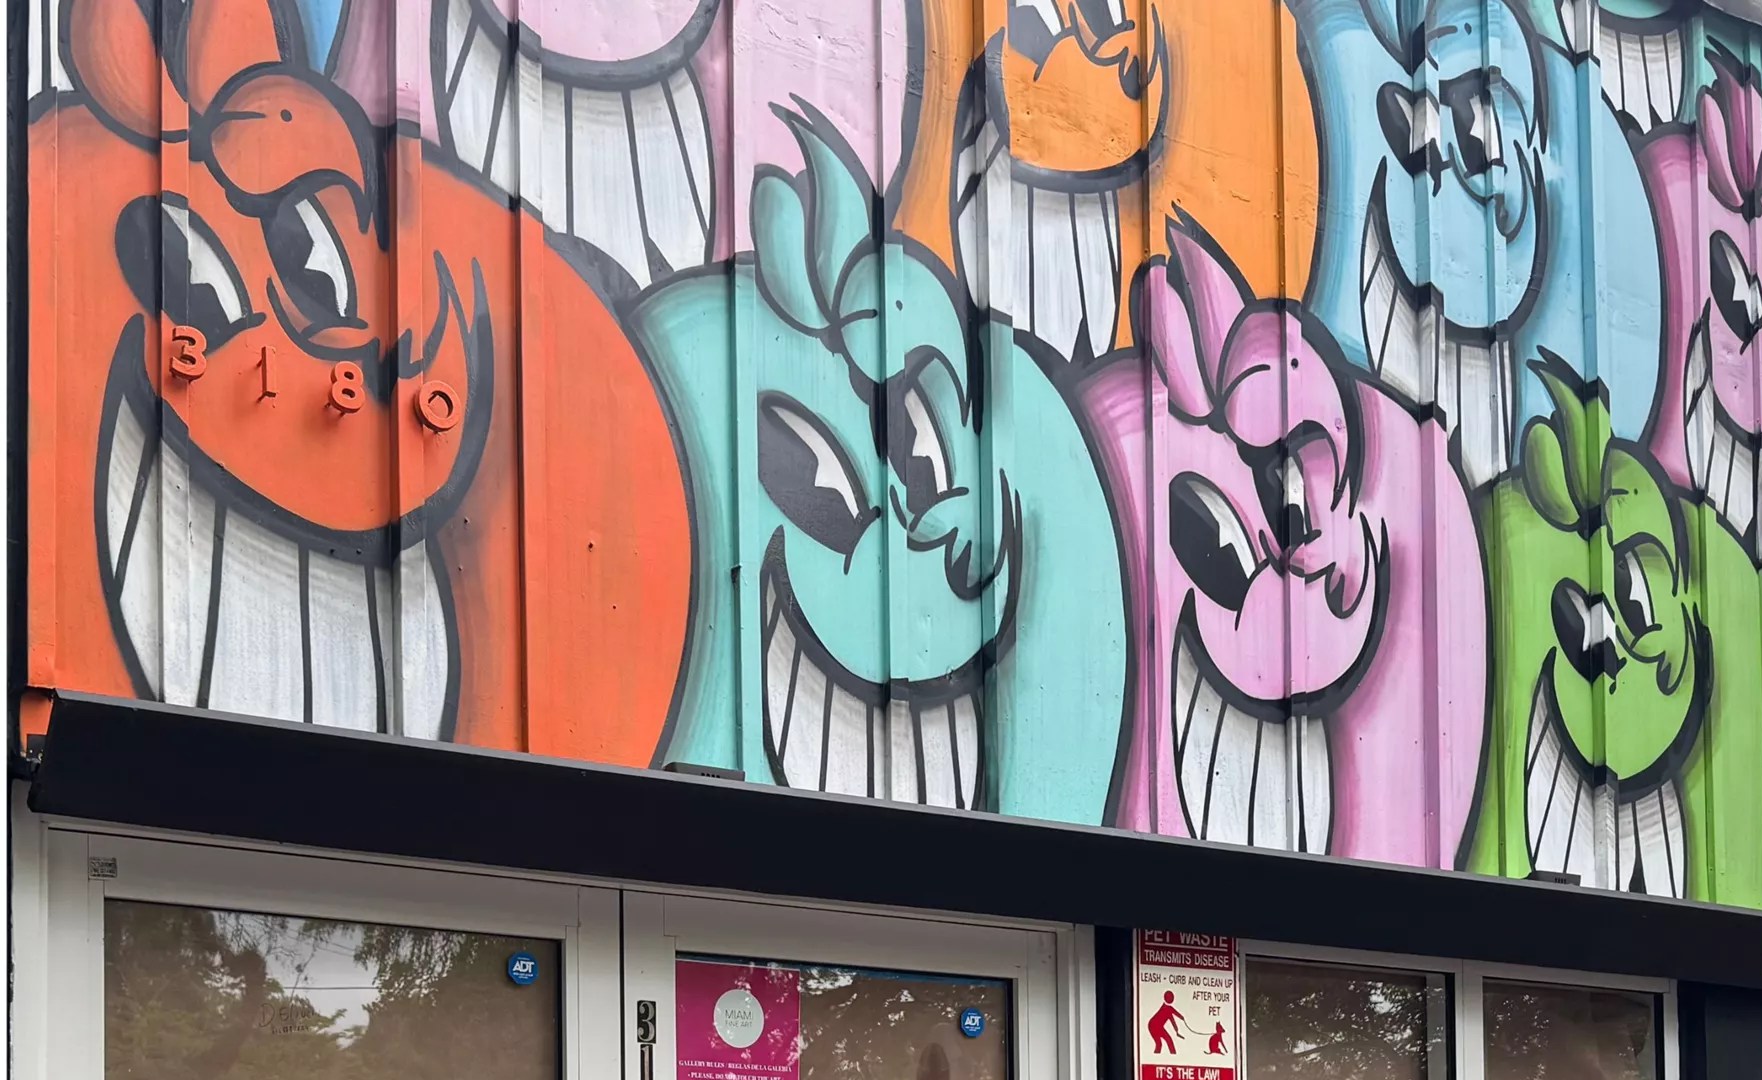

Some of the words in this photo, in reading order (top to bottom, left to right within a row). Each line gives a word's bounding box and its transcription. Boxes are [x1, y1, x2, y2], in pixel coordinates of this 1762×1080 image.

[168, 325, 462, 433] 3180
[1144, 949, 1191, 965] TRANSMITS
[1194, 953, 1230, 968] DISEASE
[512, 960, 535, 973] ADT
[1141, 972, 1162, 983] LEASH
[1168, 974, 1187, 985] CURB
[1188, 976, 1201, 986] AND
[1202, 977, 1224, 988] CLEAN
[1224, 979, 1233, 988] UP
[1192, 991, 1212, 1001] AFTER
[1213, 992, 1230, 1002] YOUR
[724, 1009, 754, 1020] MIAMI
[1208, 1006, 1221, 1016] PET
[964, 1015, 982, 1027] ADT
[678, 1060, 705, 1068] GALLERY
[706, 1061, 725, 1069] RULES
[728, 1061, 751, 1070] REGLAS
[1155, 1066, 1174, 1080] IT'S
[1176, 1067, 1195, 1080] THE
[1197, 1068, 1221, 1080] LAW!
